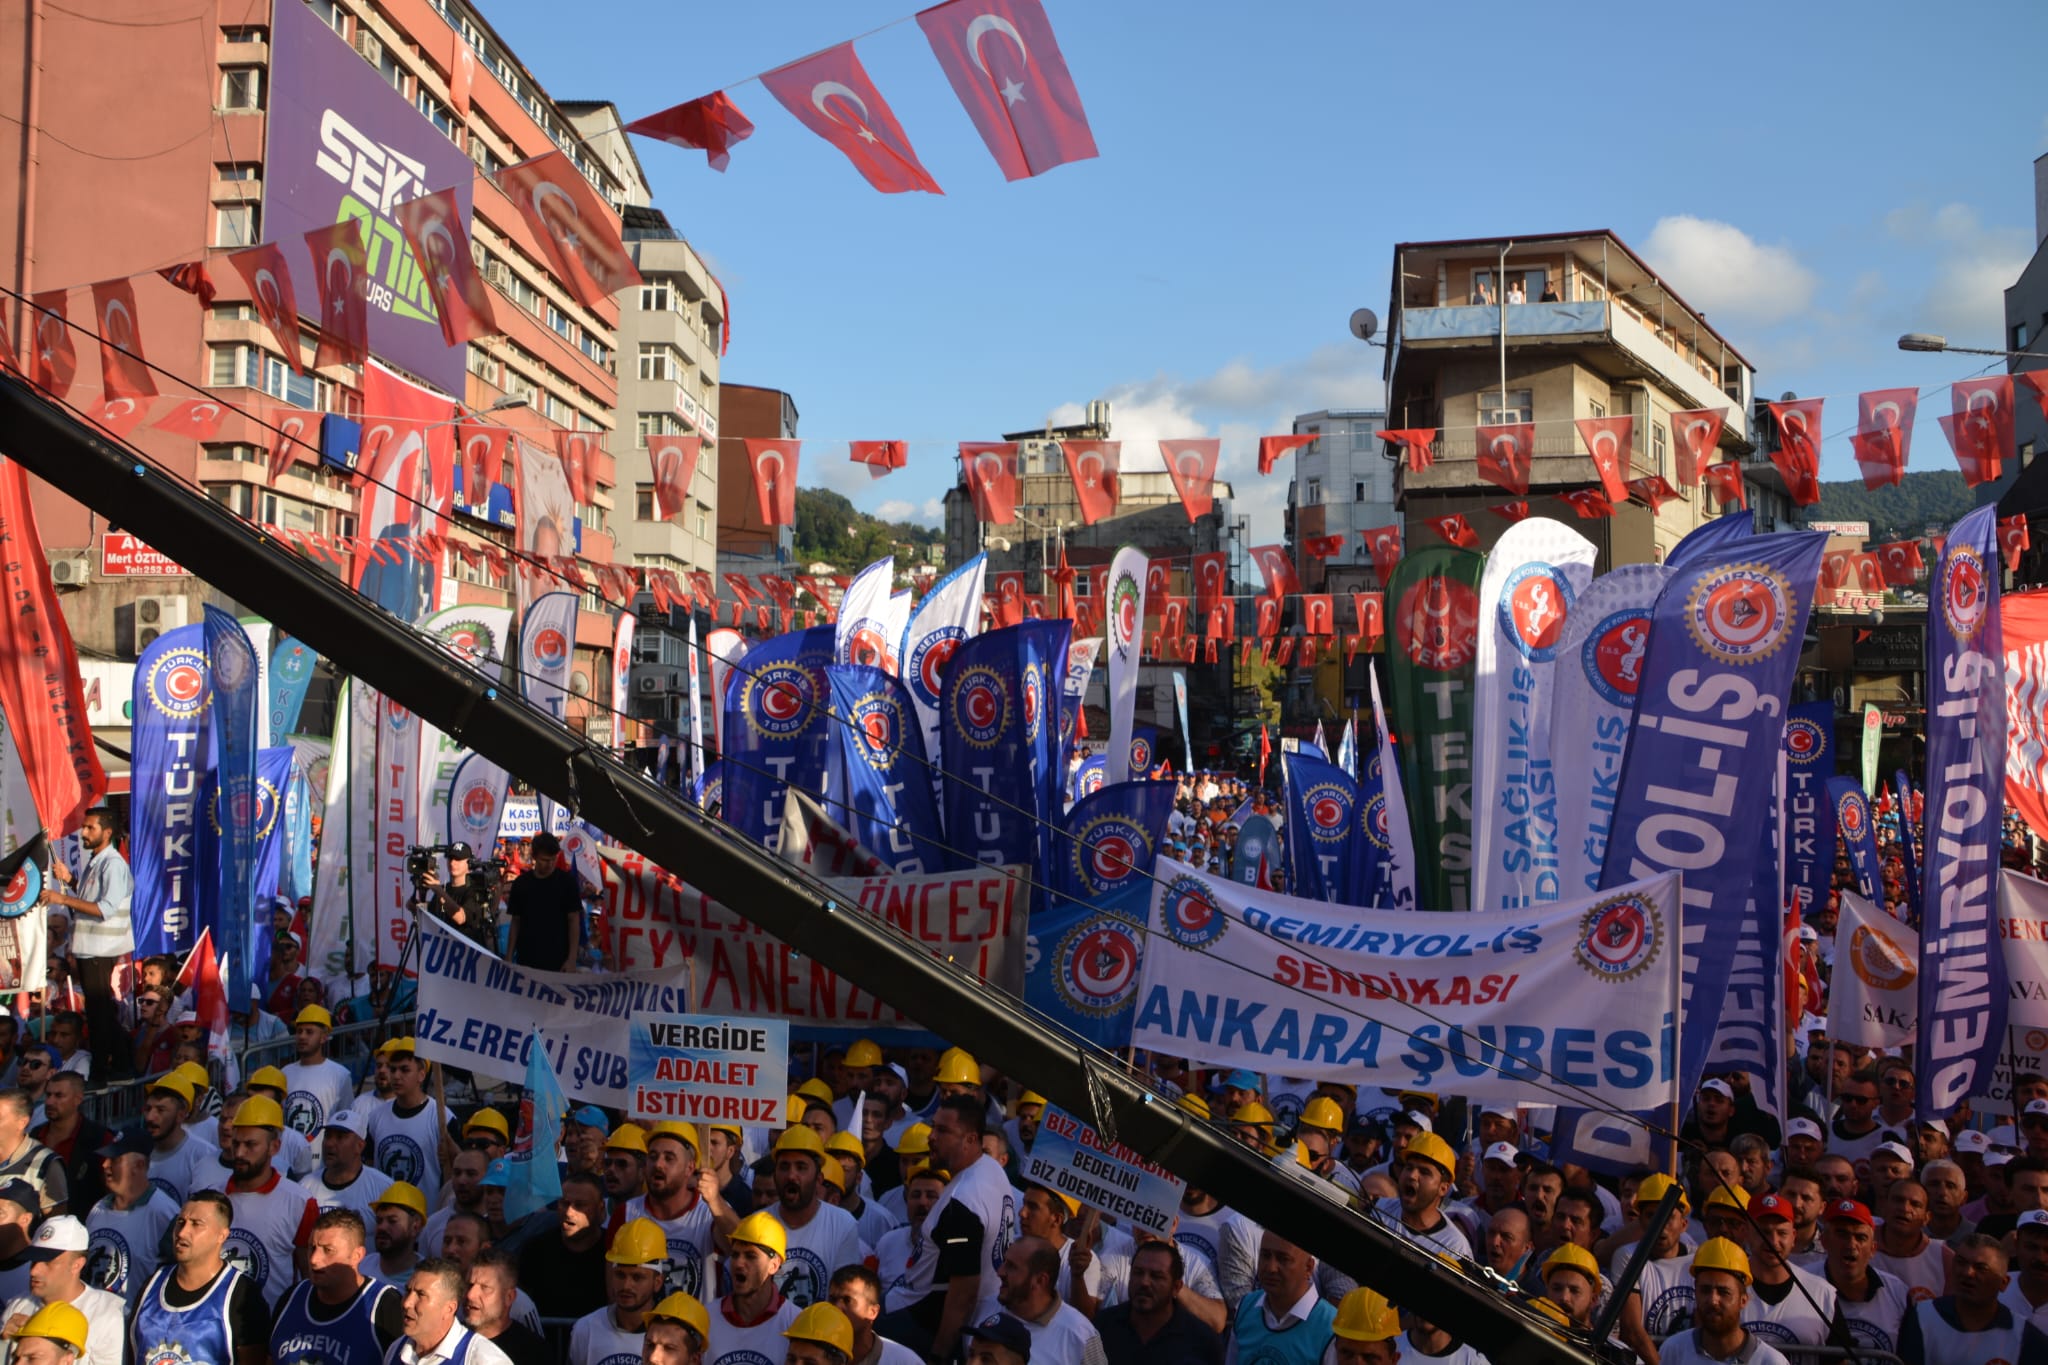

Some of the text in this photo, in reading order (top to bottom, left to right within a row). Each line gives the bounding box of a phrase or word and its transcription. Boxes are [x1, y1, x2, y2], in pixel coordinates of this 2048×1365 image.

[107, 553, 132, 563] Mert
[1711, 638, 1753, 654] 1952
[763, 719, 800, 732] 1952
[1502, 666, 1536, 874] SAĞLIK-İŞ
[162, 732, 197, 941] TÜRK-İŞ
[1791, 773, 1817, 909] TÜRK-İŞ
[1926, 649, 1995, 1110] DEMİRYOL-İŞ
[1174, 927, 1209, 943] 1952
[1242, 905, 1543, 958] DEMİRYOL-İŞ
[420, 927, 482, 984] TÜRK
[1598, 961, 1631, 973] 1952
[1273, 954, 1519, 1006] SENDİKASI
[650, 1021, 767, 1053] VERGİDE
[1135, 984, 1675, 1089] ANKARA ŞUBESİ
[655, 1057, 759, 1087] ADALET
[636, 1085, 777, 1123] İSTİYORUZ
[1045, 1111, 1076, 1139] BİZ
[1072, 1151, 1141, 1193] BEDELİNİ
[1030, 1159, 1169, 1232] BİZ ÖDEMEYECEĞİZ
[278, 1334, 350, 1362] GÖREVLİ
